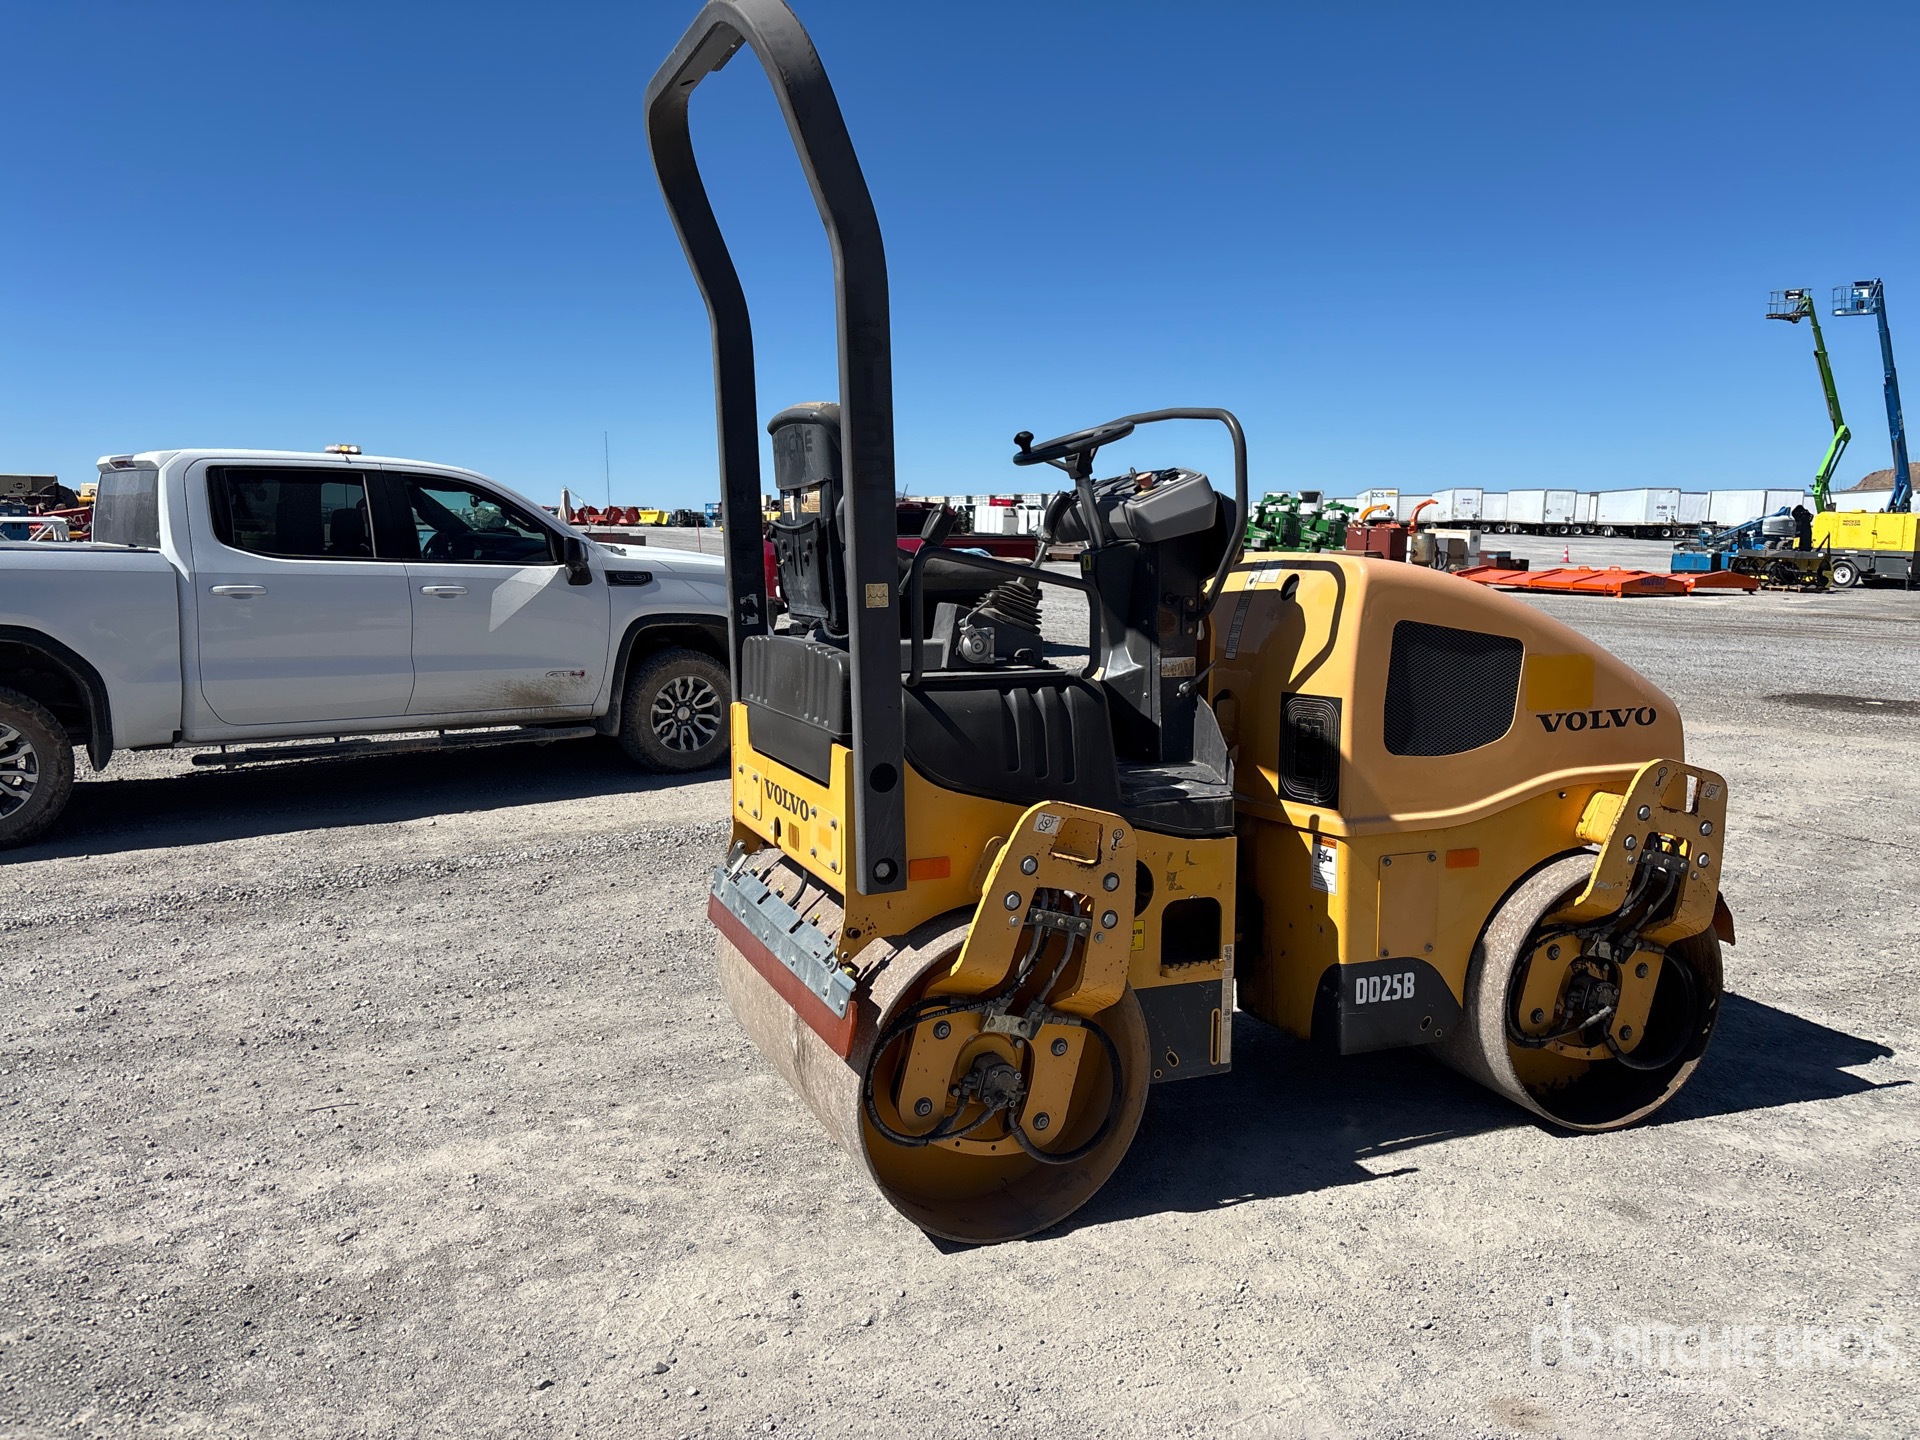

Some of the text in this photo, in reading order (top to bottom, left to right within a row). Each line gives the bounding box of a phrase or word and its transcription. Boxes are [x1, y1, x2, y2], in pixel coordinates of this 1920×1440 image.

[1536, 706, 1657, 732] VOLVO
[764, 778, 809, 822] VOLVO
[1355, 972, 1415, 1005] DD25B
